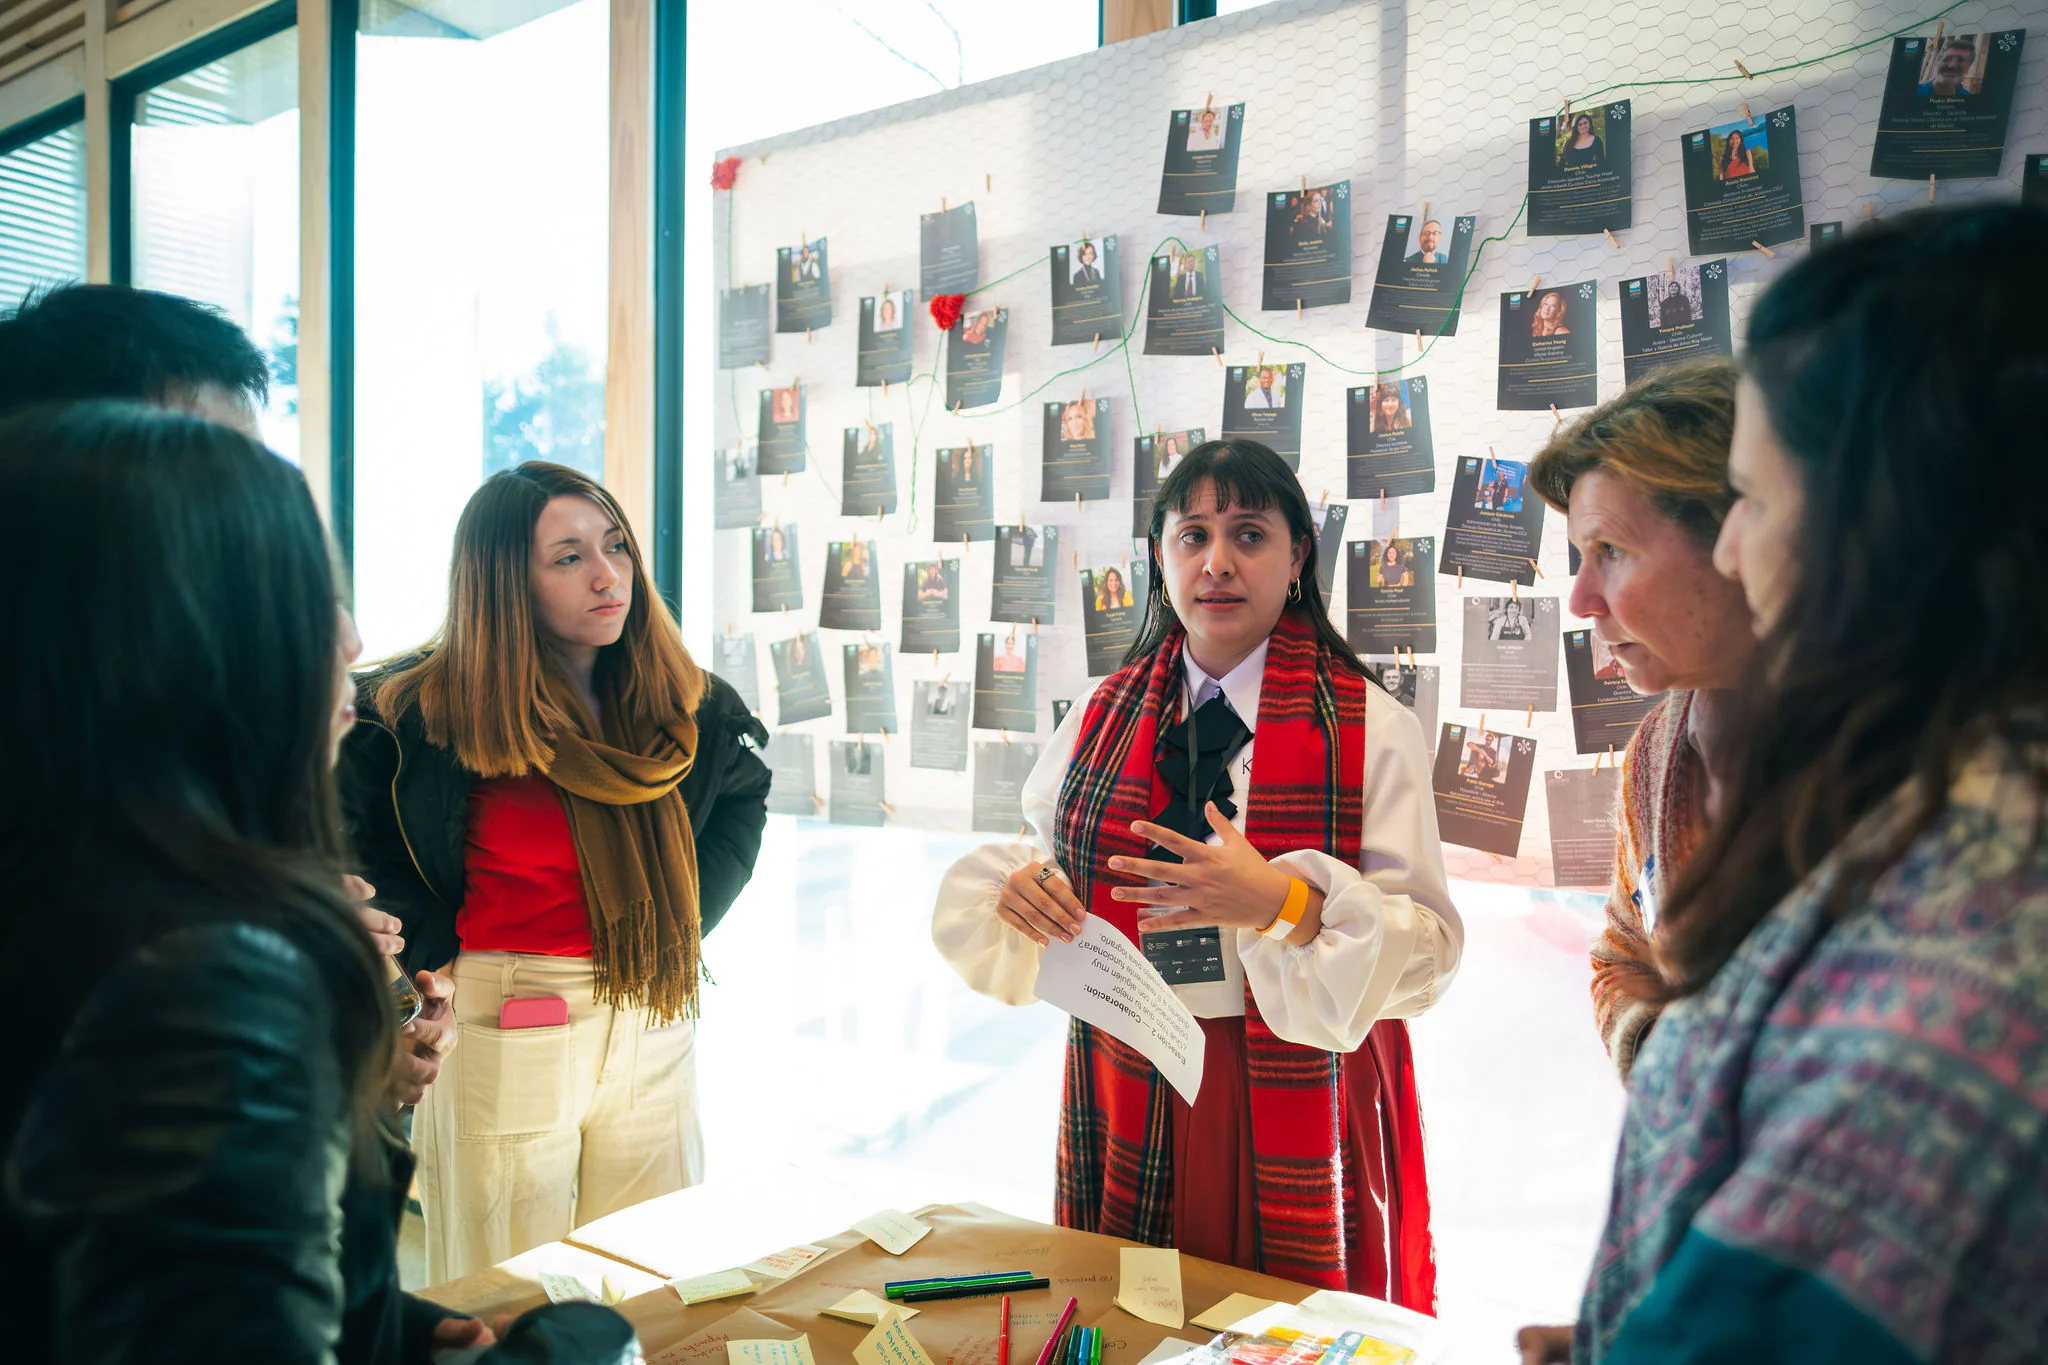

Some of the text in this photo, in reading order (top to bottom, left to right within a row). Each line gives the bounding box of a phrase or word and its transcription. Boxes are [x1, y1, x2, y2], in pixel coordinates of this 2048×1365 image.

[1078, 939, 1125, 970] funcionara?
[1099, 933, 1128, 959] lograrlo.
[1091, 958, 1110, 973] muy
[1111, 969, 1137, 991] alguien
[1126, 965, 1157, 997] realmente
[1083, 984, 1142, 1024] Colaboración:
[1112, 985, 1134, 1002] mejor
[1138, 990, 1150, 1002] con
[1143, 1006, 1155, 1021] que
[1151, 1027, 1156, 1037] 2
[1157, 1033, 1186, 1065] Estación
